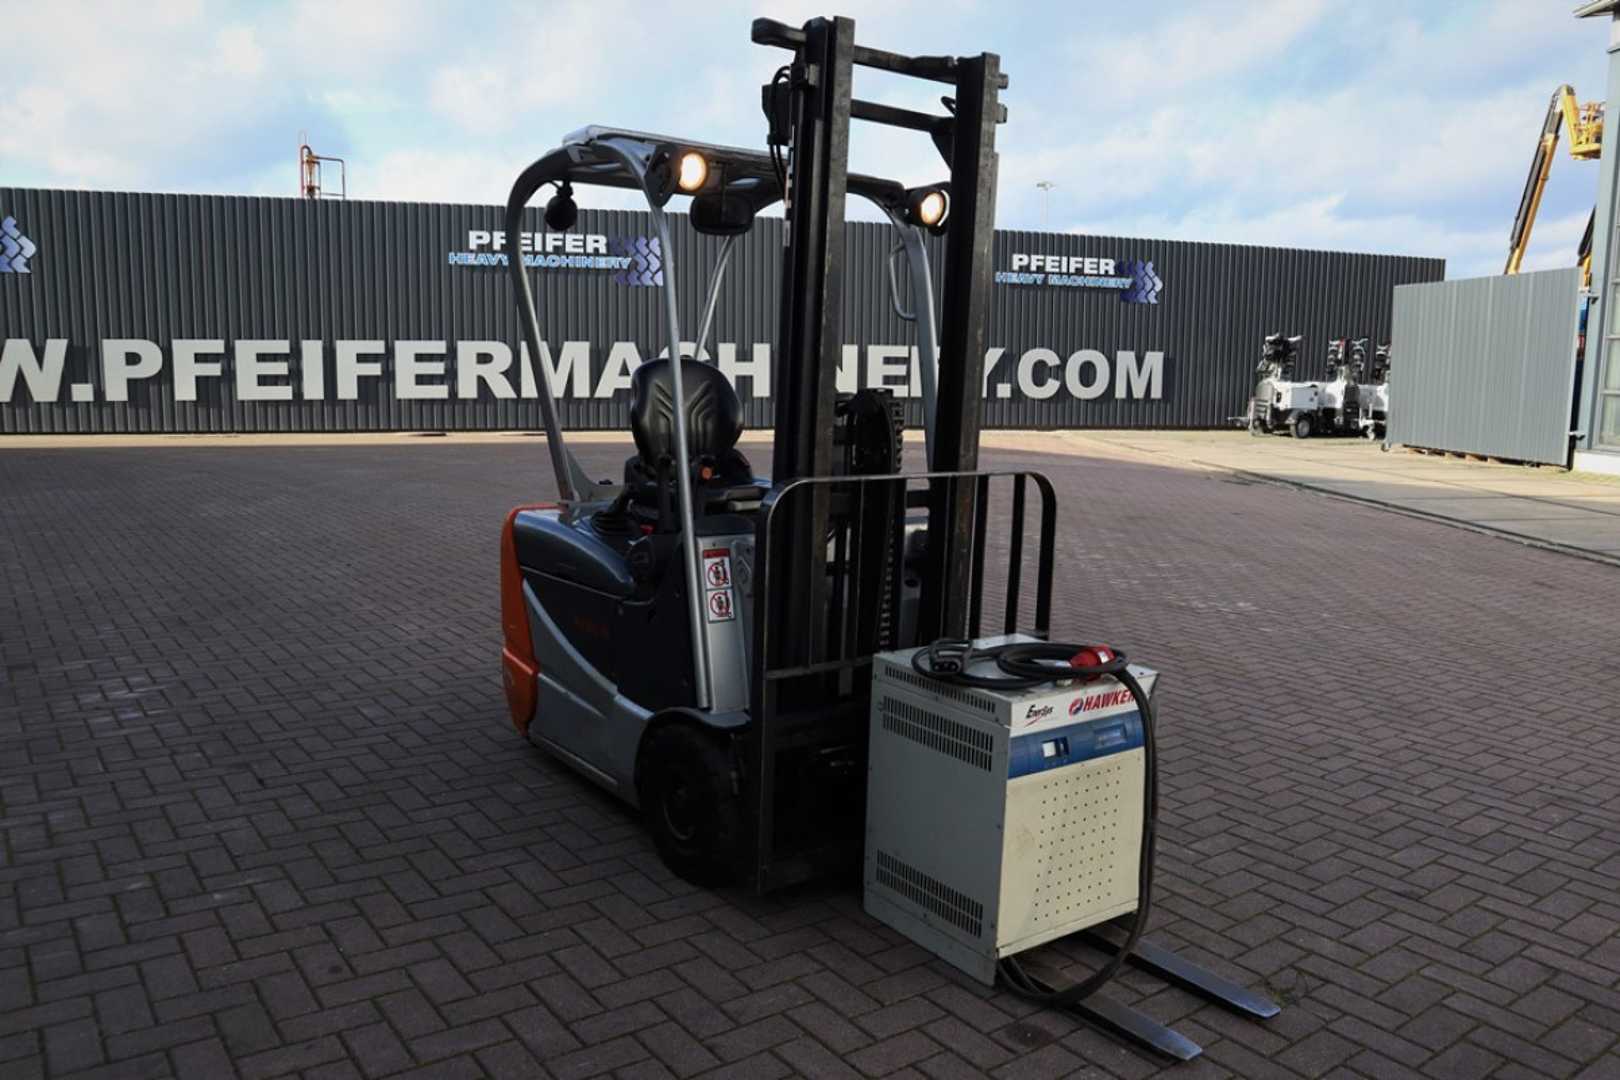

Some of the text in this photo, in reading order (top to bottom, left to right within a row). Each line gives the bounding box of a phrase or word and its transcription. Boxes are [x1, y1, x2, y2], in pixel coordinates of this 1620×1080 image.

[468, 230, 608, 254] PFEIFER
[522, 254, 632, 270] MACHINERY
[1012, 253, 1116, 275] PFEIFER
